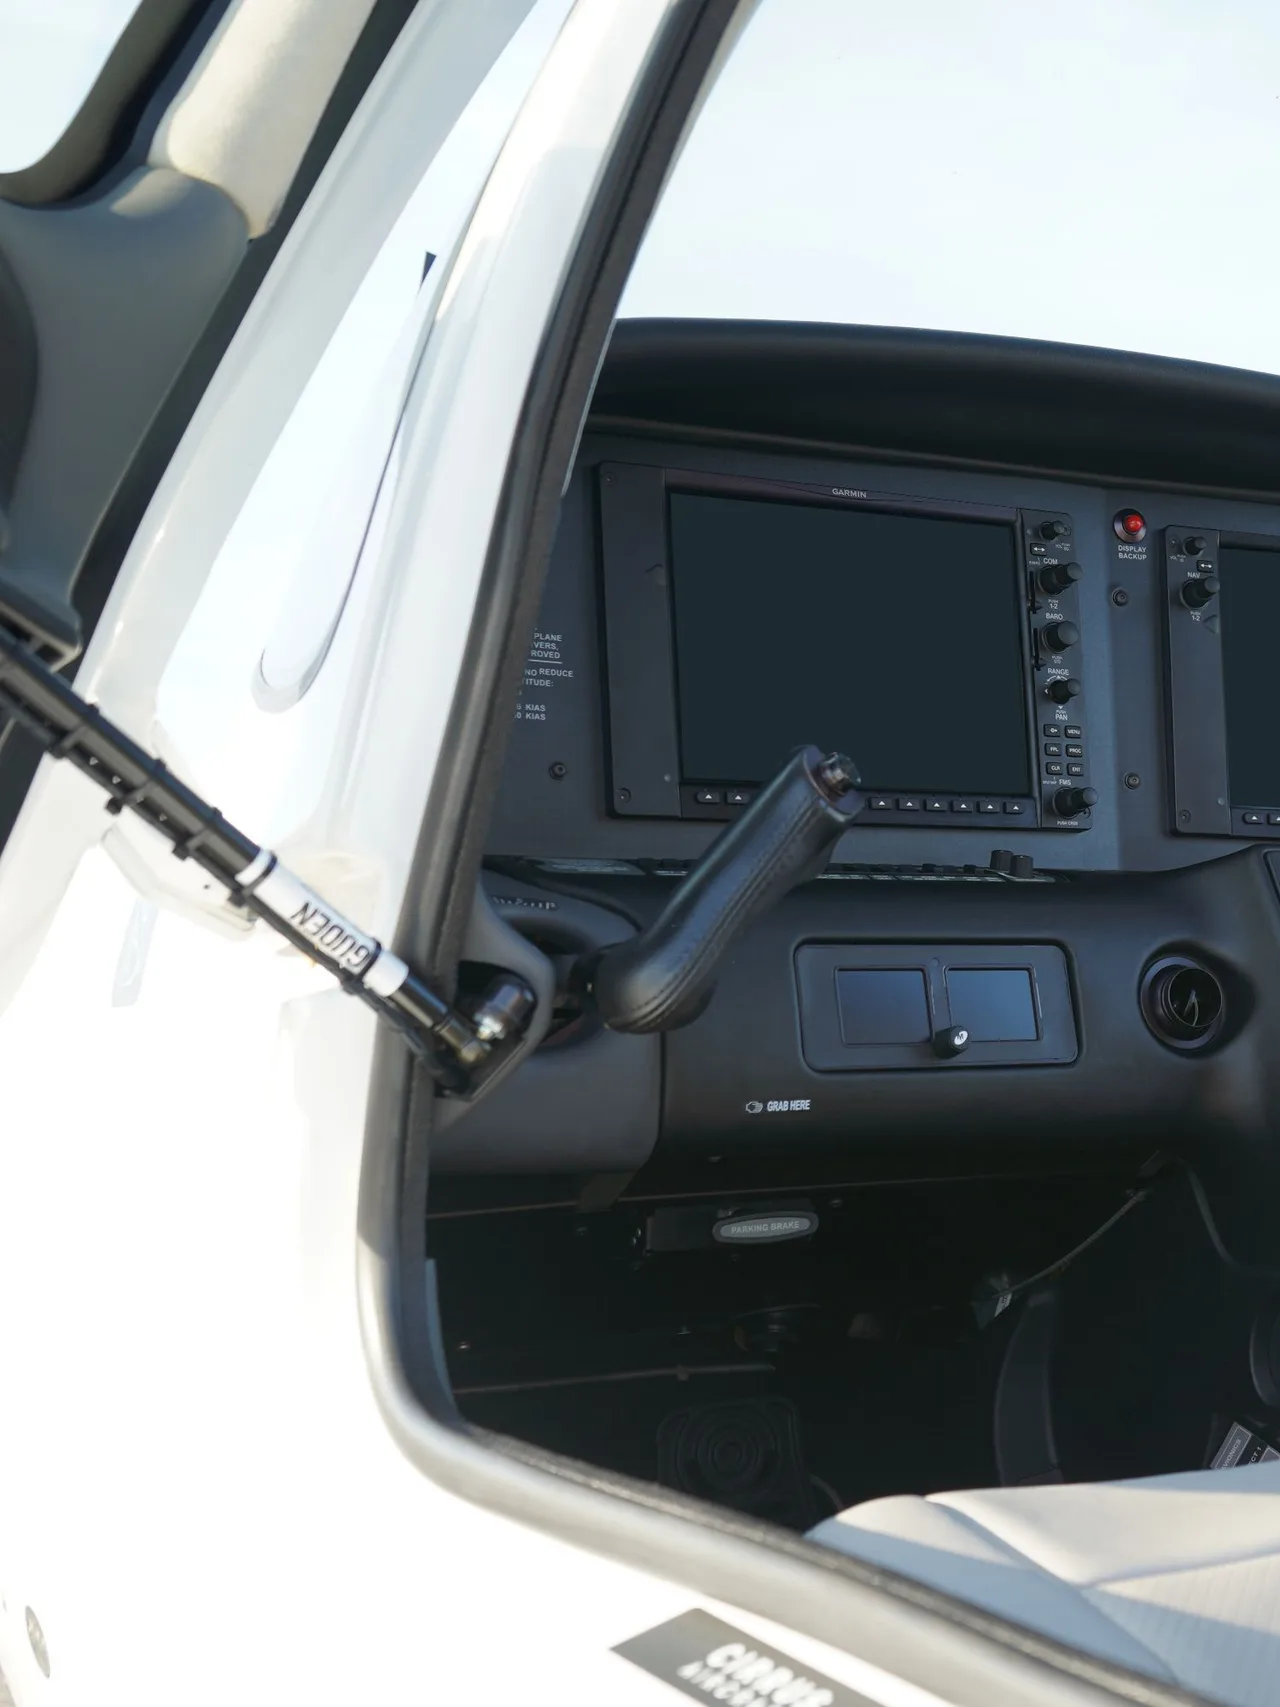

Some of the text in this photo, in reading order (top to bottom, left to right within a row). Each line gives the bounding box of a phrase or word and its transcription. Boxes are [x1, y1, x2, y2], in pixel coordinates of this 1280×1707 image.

[831, 487, 867, 498] GARMIN
[1117, 545, 1147, 553] DISPLAY
[1187, 571, 1201, 579] NAV
[1045, 612, 1064, 620] BARO
[531, 641, 559, 651] VERS,
[538, 667, 574, 678] REDUCE
[1047, 667, 1070, 676] RANGE
[522, 678, 554, 688] ITUDE:
[525, 704, 546, 712] KIAS
[525, 712, 546, 721] KIAS
[1055, 713, 1068, 721] PAN
[1058, 778, 1072, 786] FMS
[290, 901, 370, 967] GUDEN
[767, 1099, 811, 1112] GRAB HERE
[731, 1220, 800, 1235] PARKING BRAKE
